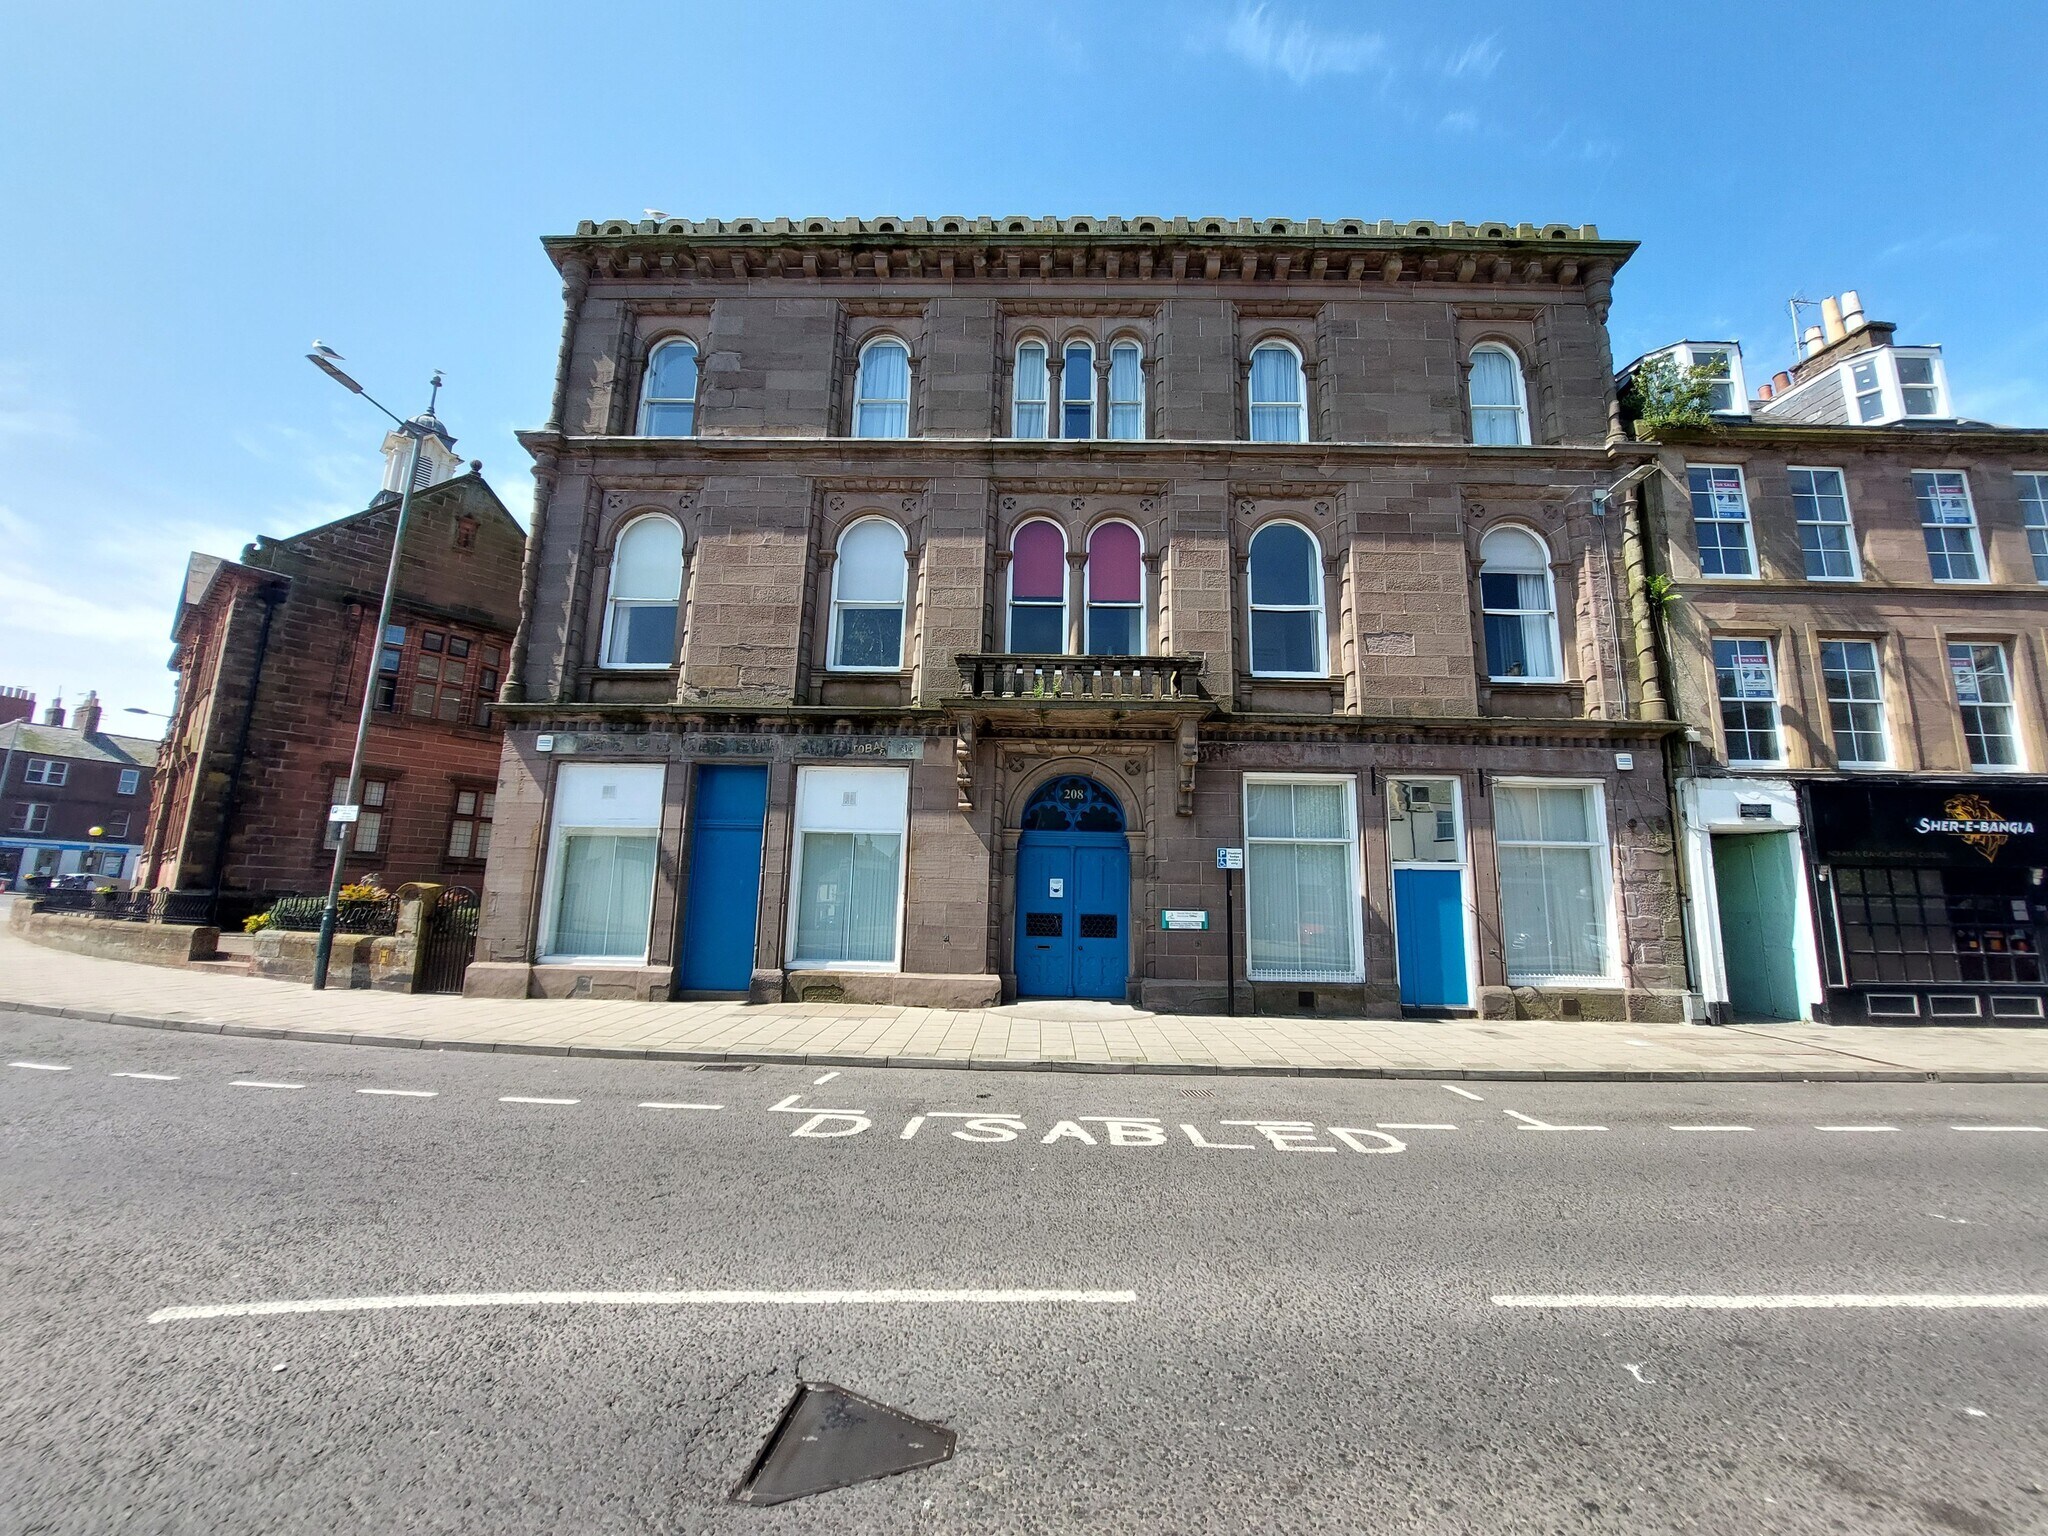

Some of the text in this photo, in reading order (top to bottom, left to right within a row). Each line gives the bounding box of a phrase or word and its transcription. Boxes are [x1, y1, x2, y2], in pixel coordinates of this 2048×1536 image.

[1063, 789, 1084, 800] 208
[1914, 818, 2035, 834] SHER-E-BANGLA
[789, 1112, 1408, 1154] DISABLED
